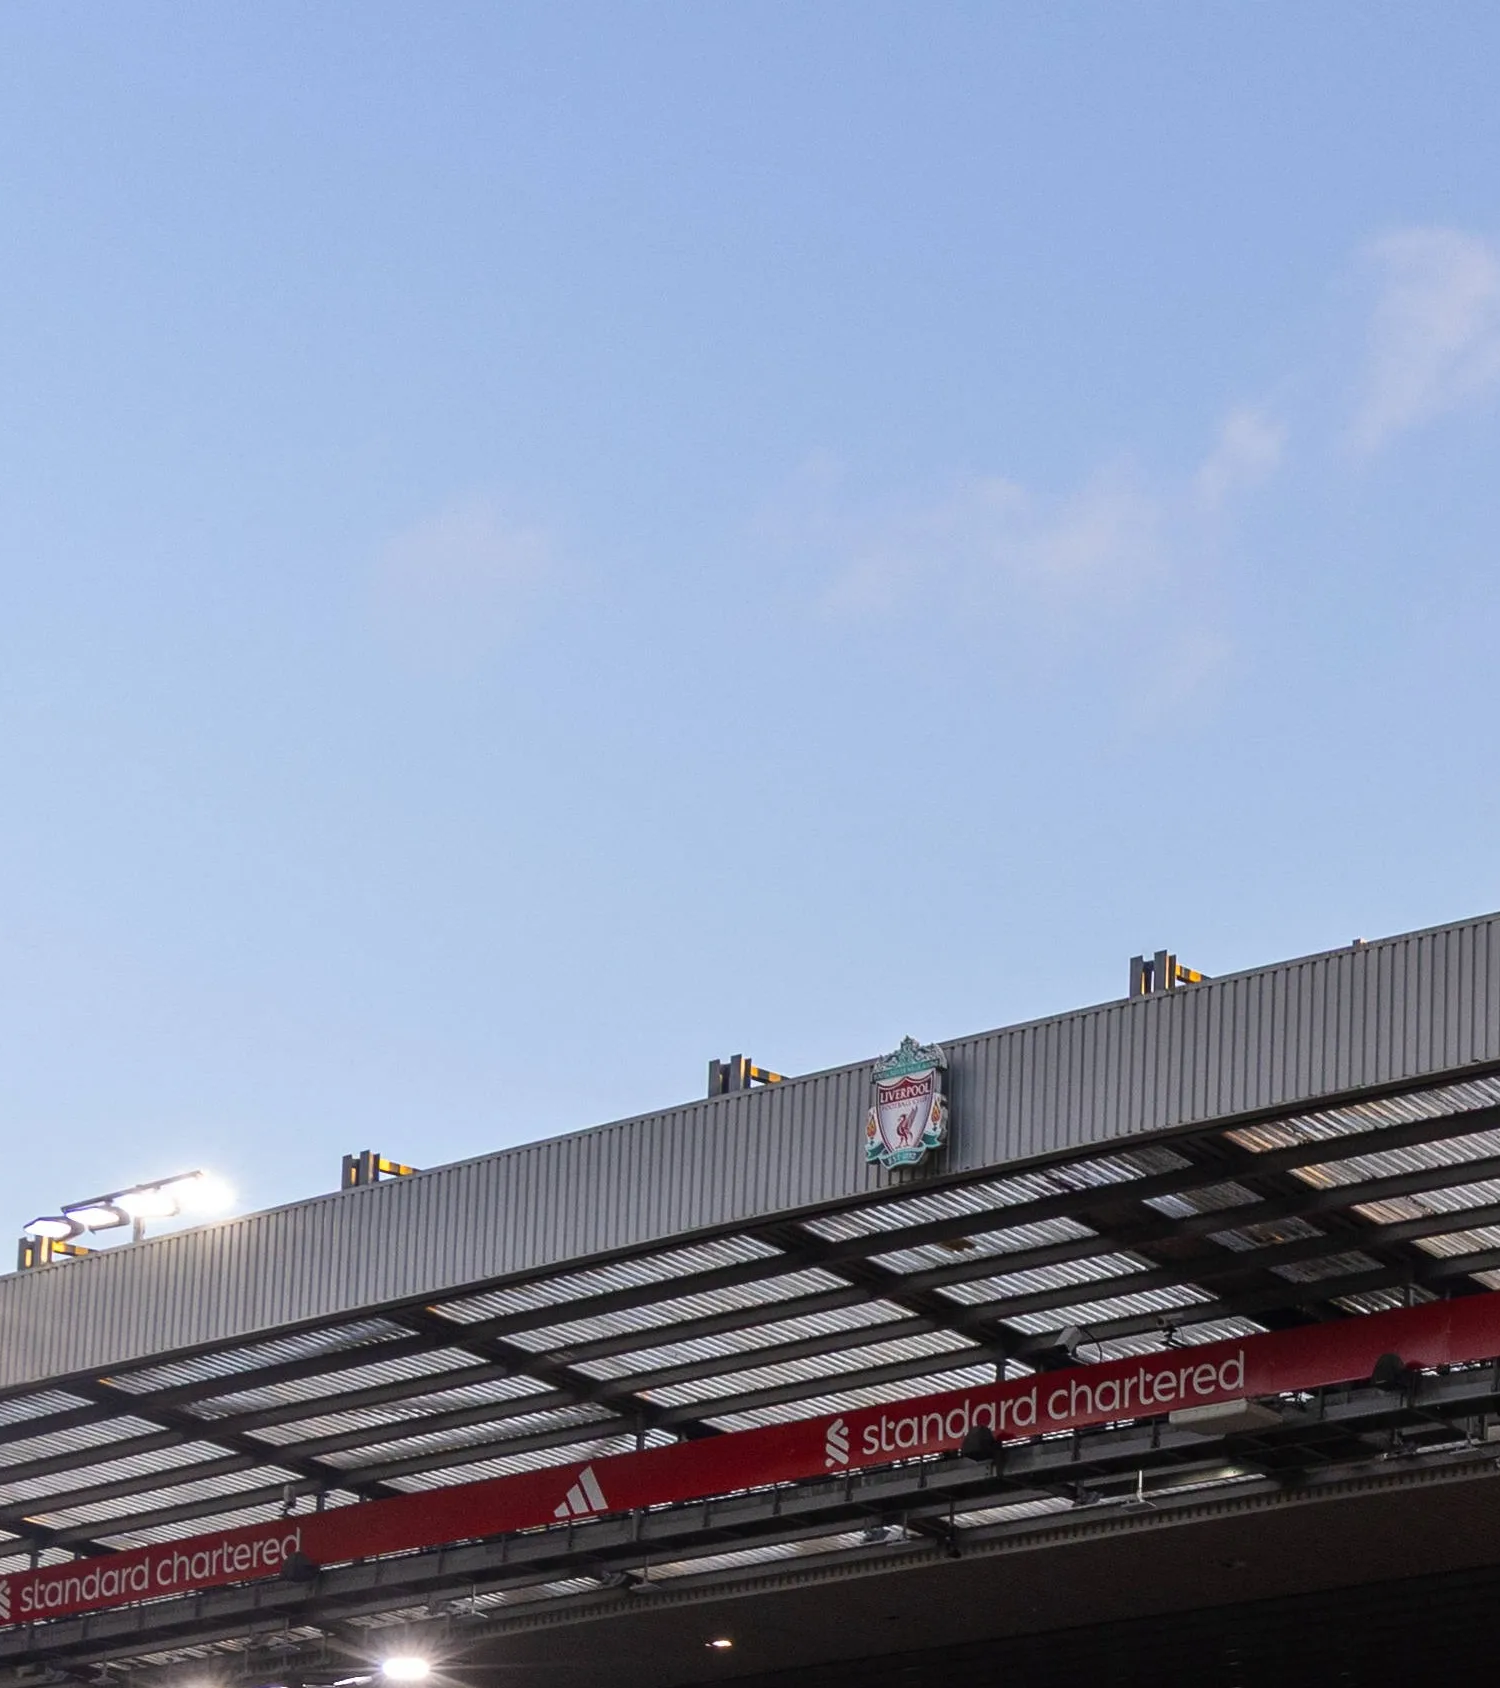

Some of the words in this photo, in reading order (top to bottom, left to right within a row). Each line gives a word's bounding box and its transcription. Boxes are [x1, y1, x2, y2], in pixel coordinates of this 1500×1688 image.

[880, 1083, 929, 1103] LIVERPOOL
[862, 1386, 1037, 1456] standard
[1047, 1350, 1244, 1420] chartered
[20, 1557, 149, 1613] standard
[156, 1527, 301, 1585] chartered
